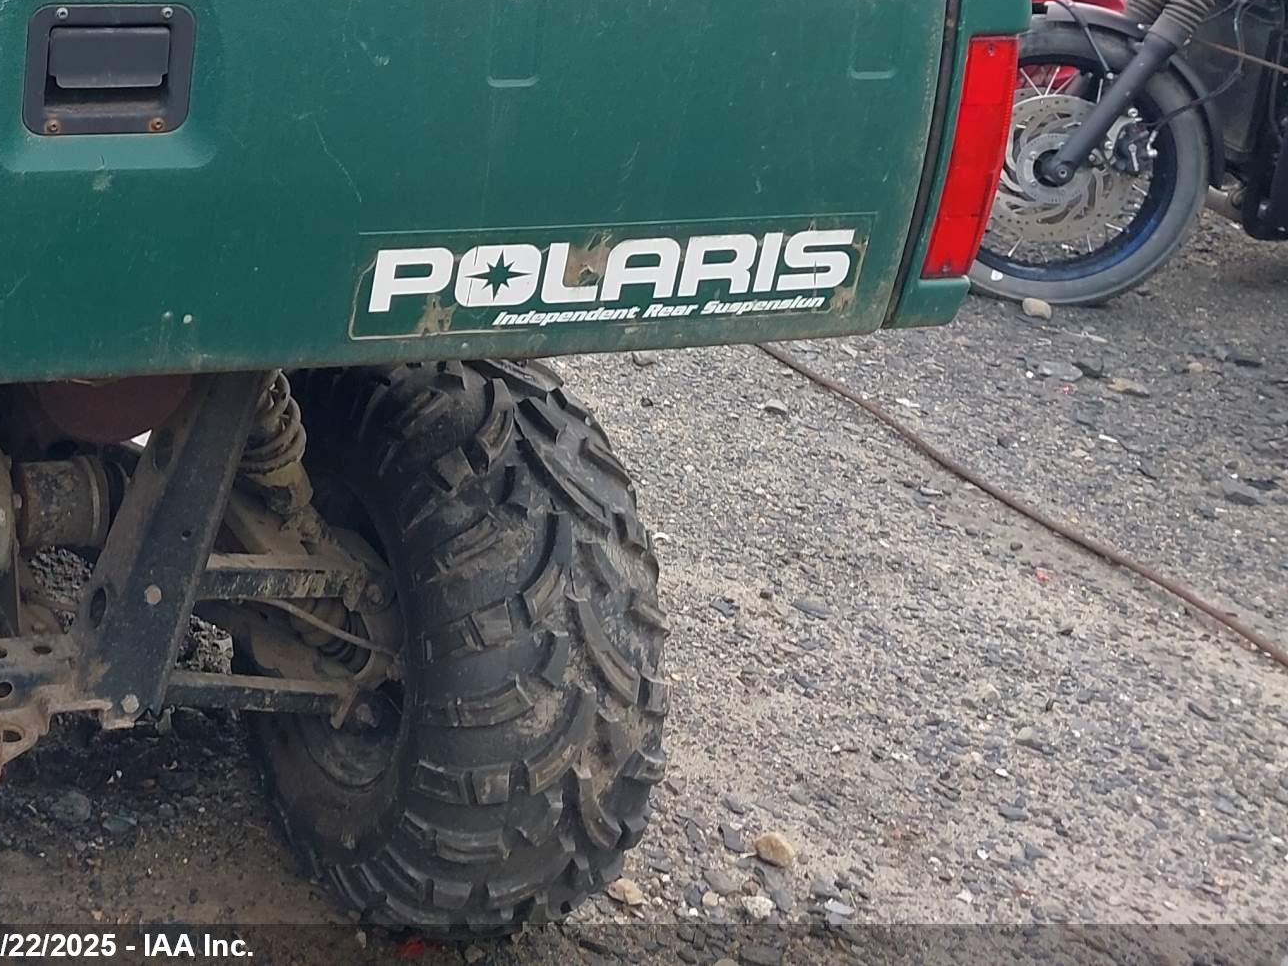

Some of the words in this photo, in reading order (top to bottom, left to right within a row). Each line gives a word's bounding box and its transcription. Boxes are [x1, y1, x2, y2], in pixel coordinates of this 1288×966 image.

[368, 229, 855, 313] POLARIS
[492, 306, 640, 326] Independent
[642, 303, 699, 319] Rear
[700, 295, 825, 315] Suspension
